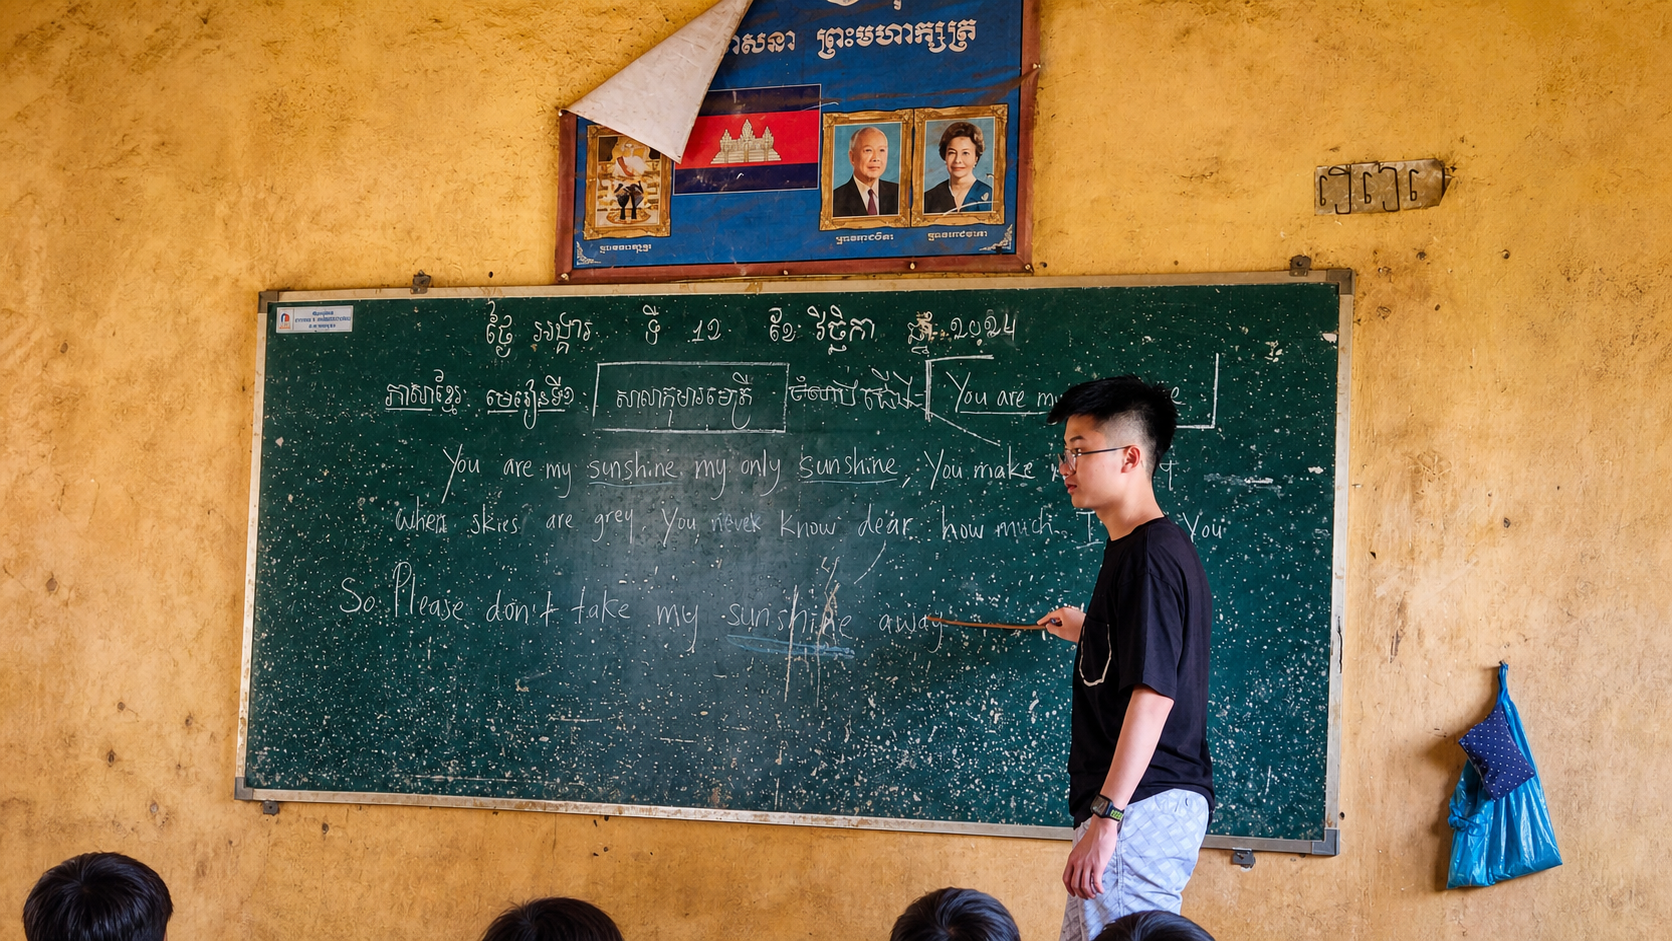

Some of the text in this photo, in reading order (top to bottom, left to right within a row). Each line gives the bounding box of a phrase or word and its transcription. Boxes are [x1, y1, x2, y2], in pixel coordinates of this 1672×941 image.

[816, 18, 977, 60] ព្រះមហាក្សត្រ
[946, 371, 988, 413] You
[997, 389, 1026, 408] are
[441, 443, 480, 504] You
[503, 458, 534, 478] are
[546, 463, 572, 498] my
[695, 459, 726, 500] my
[741, 449, 780, 496] only
[924, 448, 963, 490] You
[974, 445, 1036, 480] make
[470, 503, 518, 535] skies
[546, 513, 575, 529] are
[858, 503, 914, 537] dear
[942, 505, 985, 540] how
[1182, 512, 1222, 544] You
[393, 561, 464, 622] Please
[486, 589, 560, 628] don't
[571, 586, 631, 625] take
[657, 604, 698, 653] my
[878, 611, 949, 654] away
